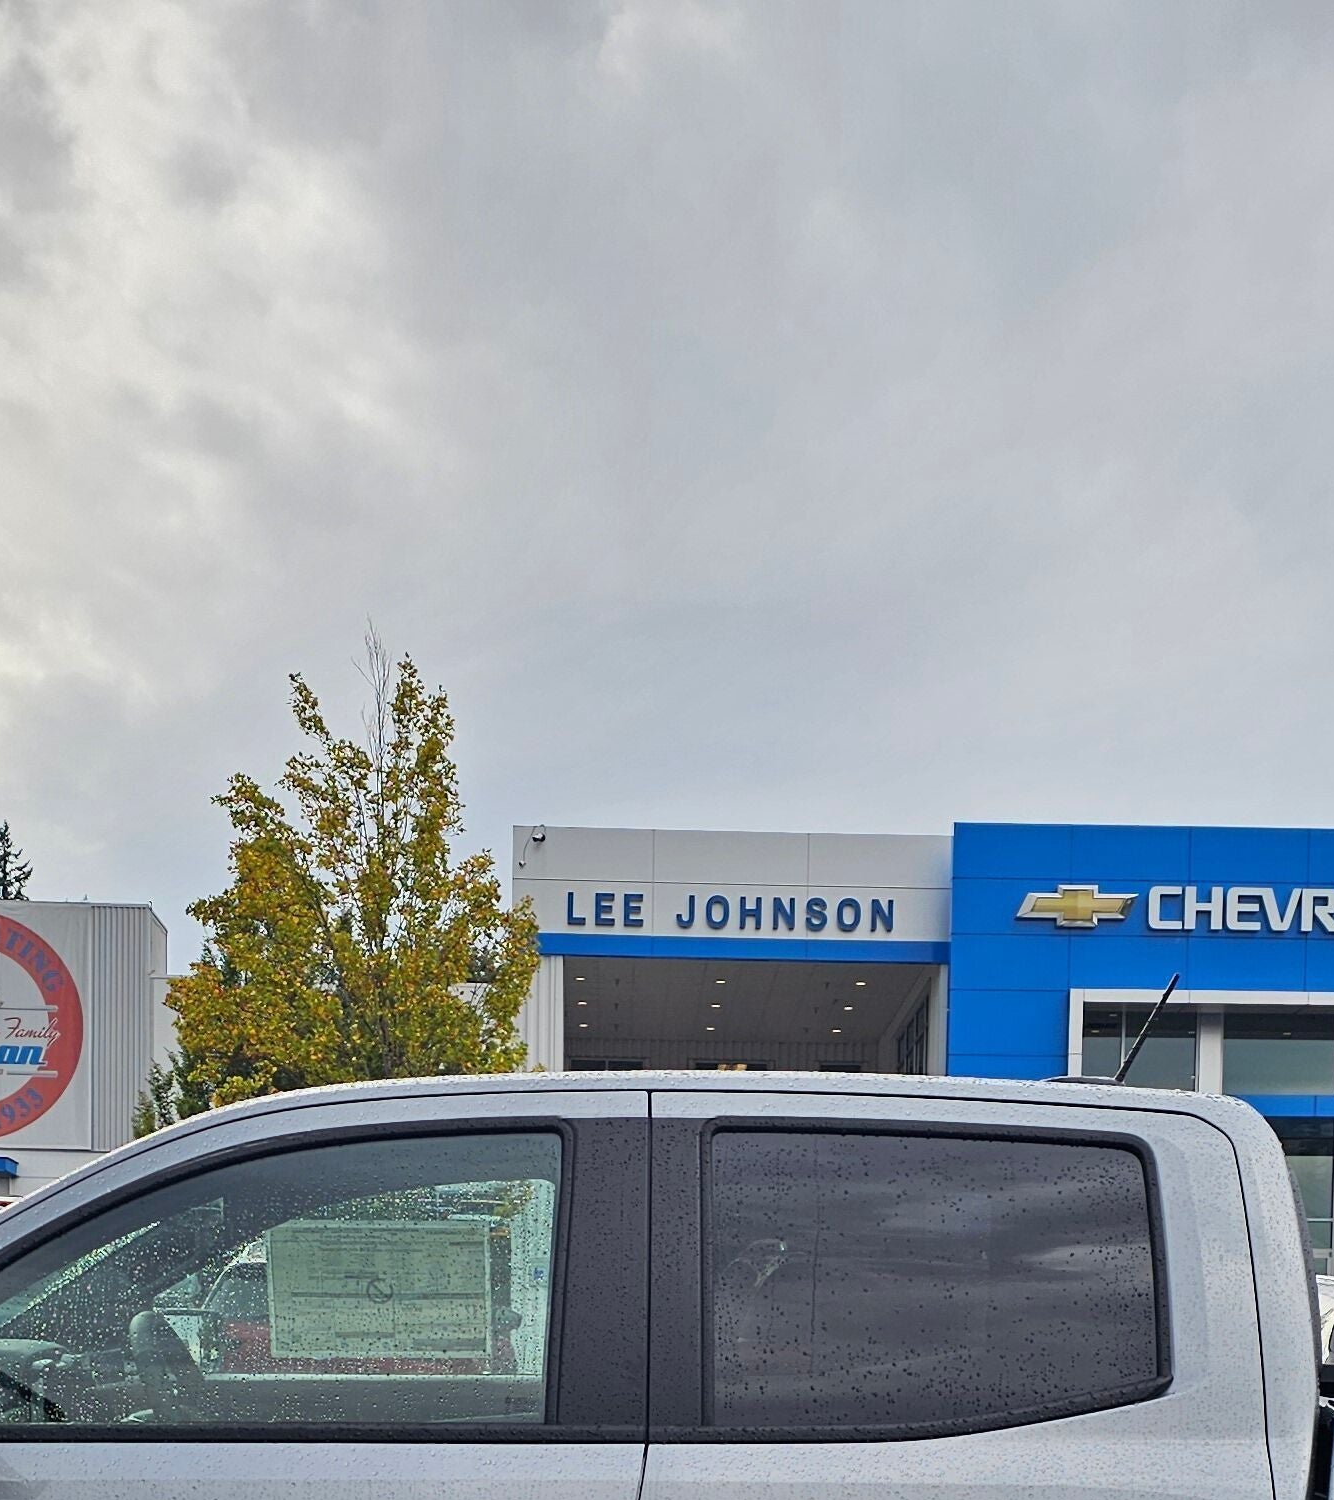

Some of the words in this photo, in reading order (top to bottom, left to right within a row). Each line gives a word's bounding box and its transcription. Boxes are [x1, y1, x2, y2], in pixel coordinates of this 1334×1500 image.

[567, 892, 644, 927] LEE
[676, 894, 895, 932] JOHNSON
[3, 1016, 62, 1047] Family
